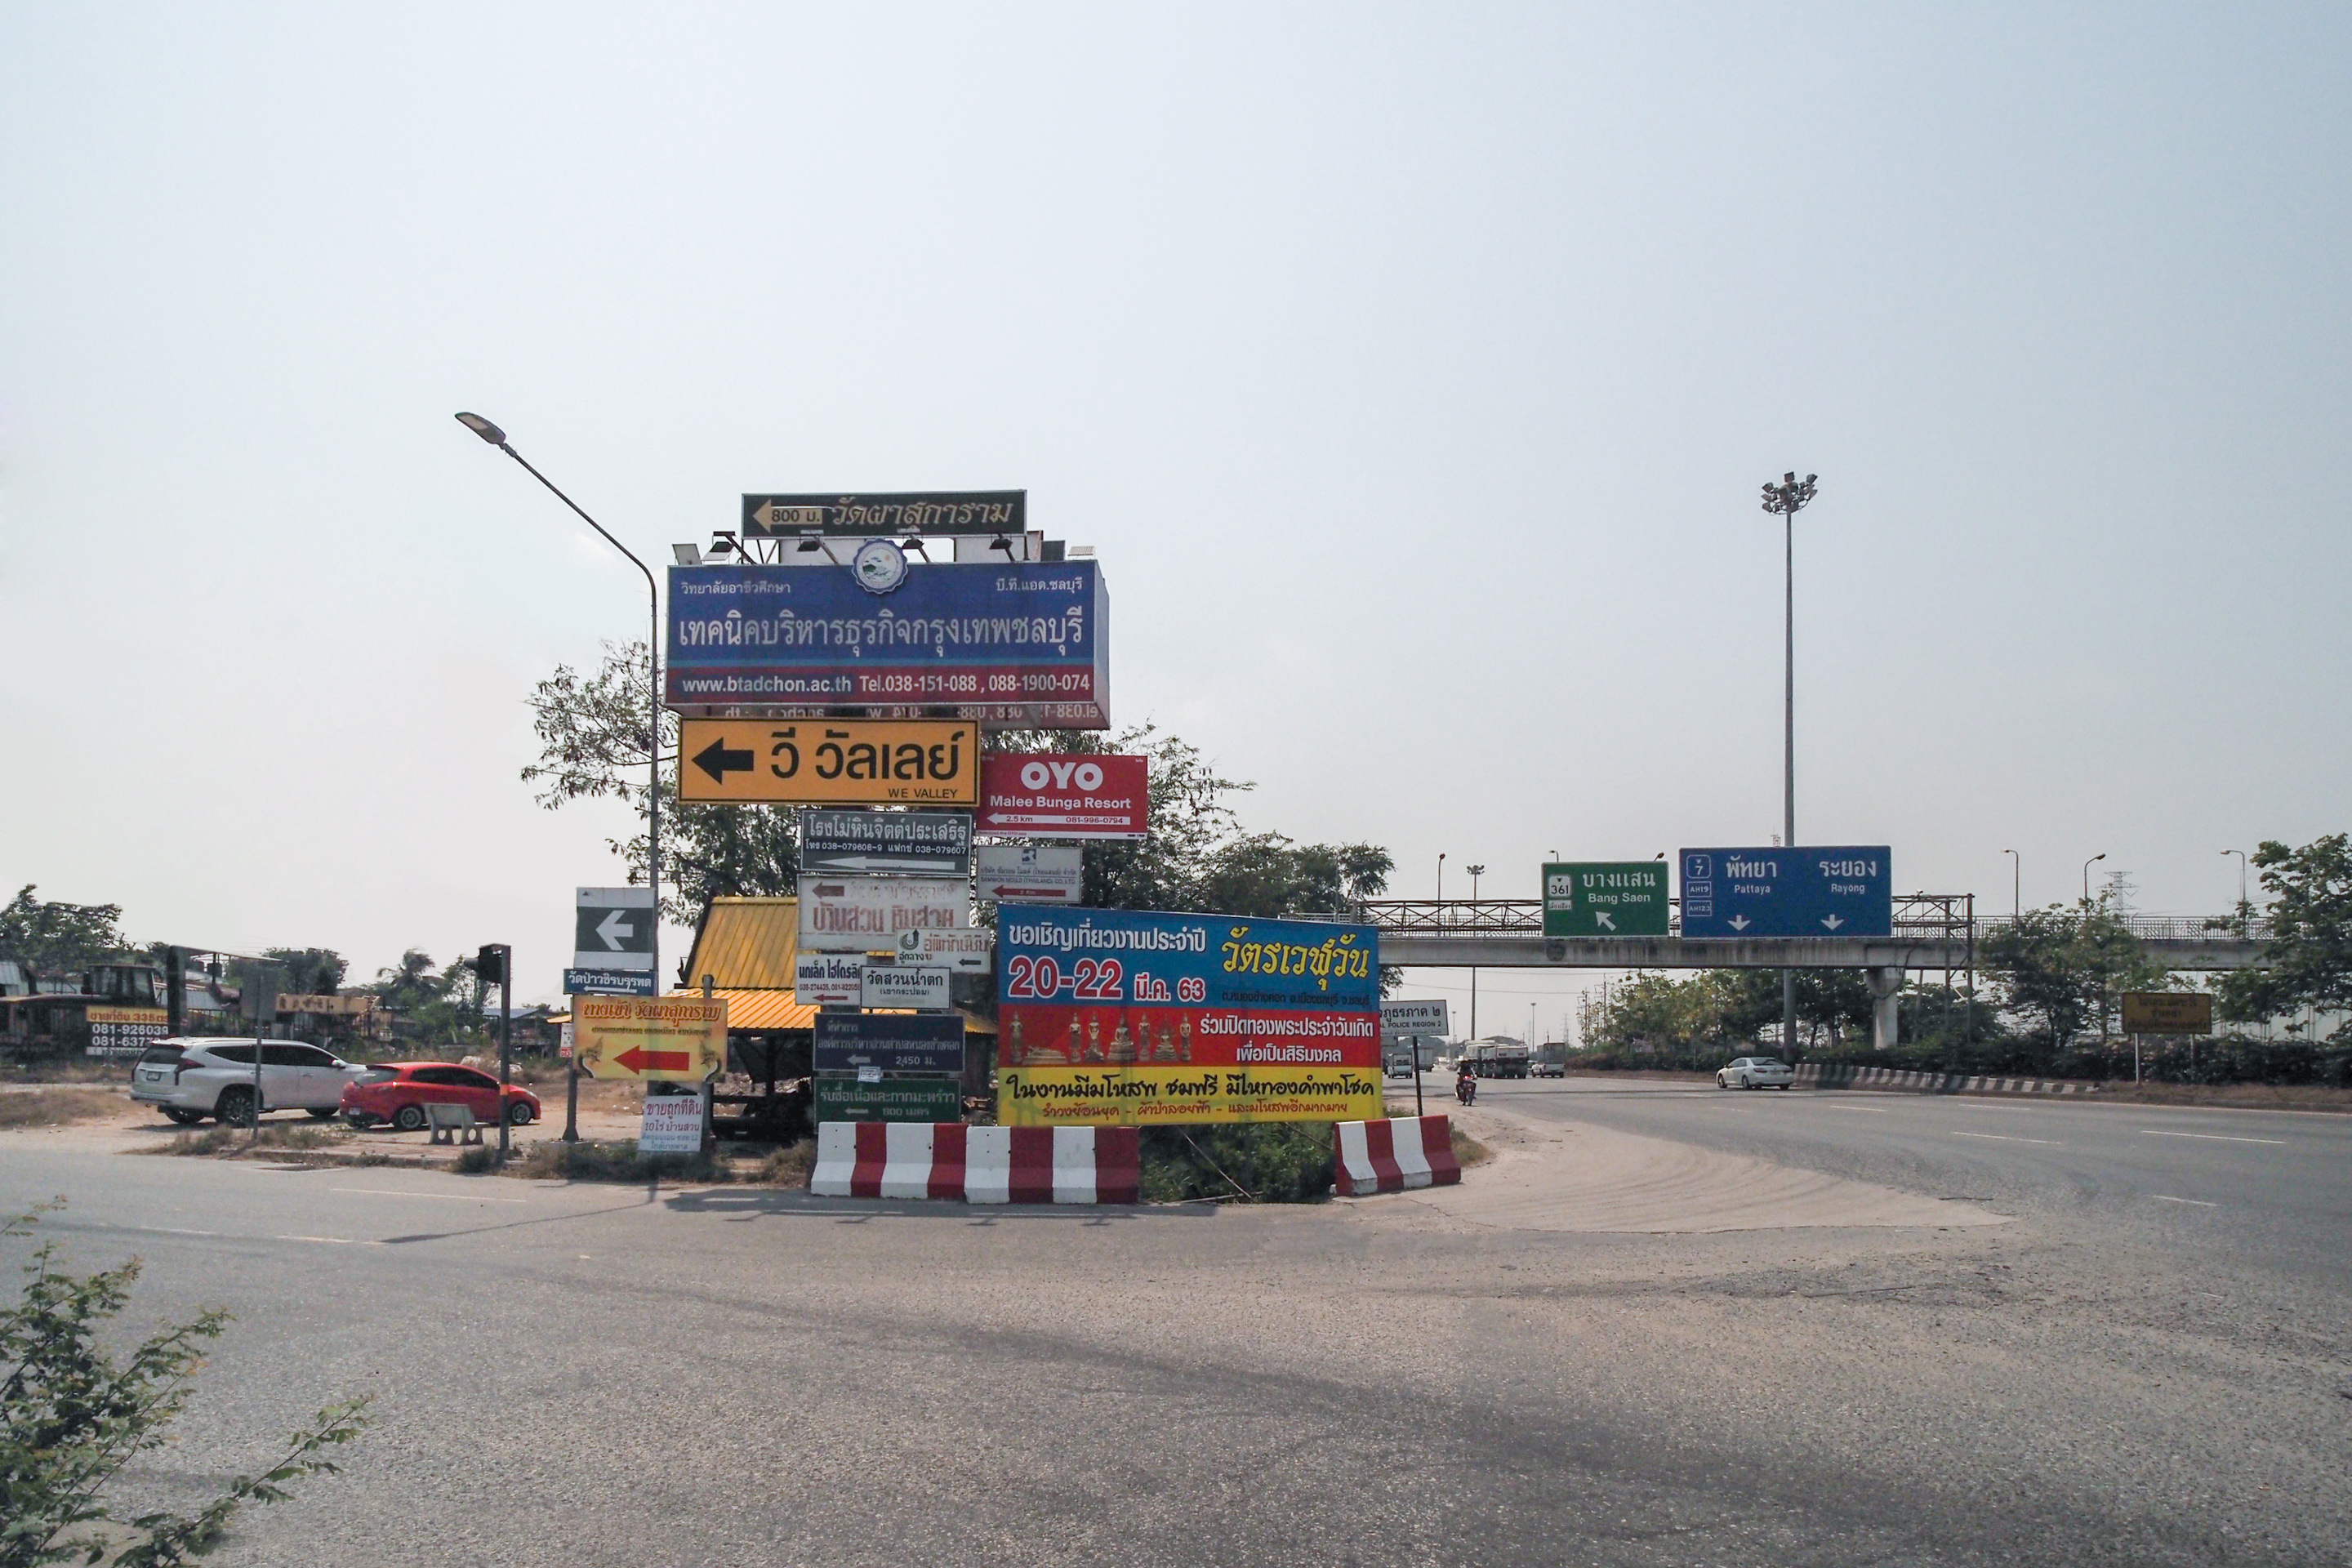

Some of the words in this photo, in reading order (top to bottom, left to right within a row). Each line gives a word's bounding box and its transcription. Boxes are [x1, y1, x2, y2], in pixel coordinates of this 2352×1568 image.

[771, 510, 800, 522] 800
[805, 510, 820, 523] ม.
[681, 581, 791, 595] วิทยาลัยอาชีวศึกษา
[679, 606, 1083, 657] เทคนิคบริหารธุรกิจกรุงเทพชลบุรี
[683, 675, 852, 693] www.btadchon.ac.th
[988, 674, 1090, 692] 088-1900-074
[770, 727, 800, 780] วี
[815, 728, 964, 780] วัลเลย์
[1021, 761, 1103, 791] OYO
[889, 788, 910, 798] WE
[915, 789, 958, 799] VALLEY
[990, 795, 1033, 807] Malee
[1036, 796, 1081, 810] Bunga
[1085, 797, 1131, 808] Resort
[822, 842, 883, 851] 038-079608-9
[915, 845, 967, 854] 038-079607
[1695, 865, 1704, 875] 7
[1726, 854, 1777, 878] พัทยา
[1819, 858, 1877, 878] ระยอง
[1582, 871, 1656, 888] บางแสน
[1551, 884, 1570, 895] 361
[1588, 893, 1618, 904] Bang
[1622, 893, 1651, 903] Saen
[1735, 884, 1771, 895] Pattaya
[1831, 883, 1866, 896] Rayong
[1009, 918, 1206, 952] ขอเชิญเที่ยวงานประจำปี
[866, 968, 943, 987] วัดสวนน้ำตก
[1008, 955, 1123, 1000] 20-22
[1134, 972, 1171, 1001] มี.ค.
[1178, 977, 1206, 1002] 63
[584, 1000, 631, 1018] ทางเข้า
[1200, 1013, 1374, 1037] ร่วมปิดทองพระประจำวันเกิด
[1236, 1040, 1342, 1062] เพื่อเป็นสิริมงคล
[1006, 1074, 1158, 1099] ในงานมีมโหสพ
[1166, 1074, 1218, 1097] ชมฟรี
[646, 1098, 702, 1119] ขายถูกที่ดิน
